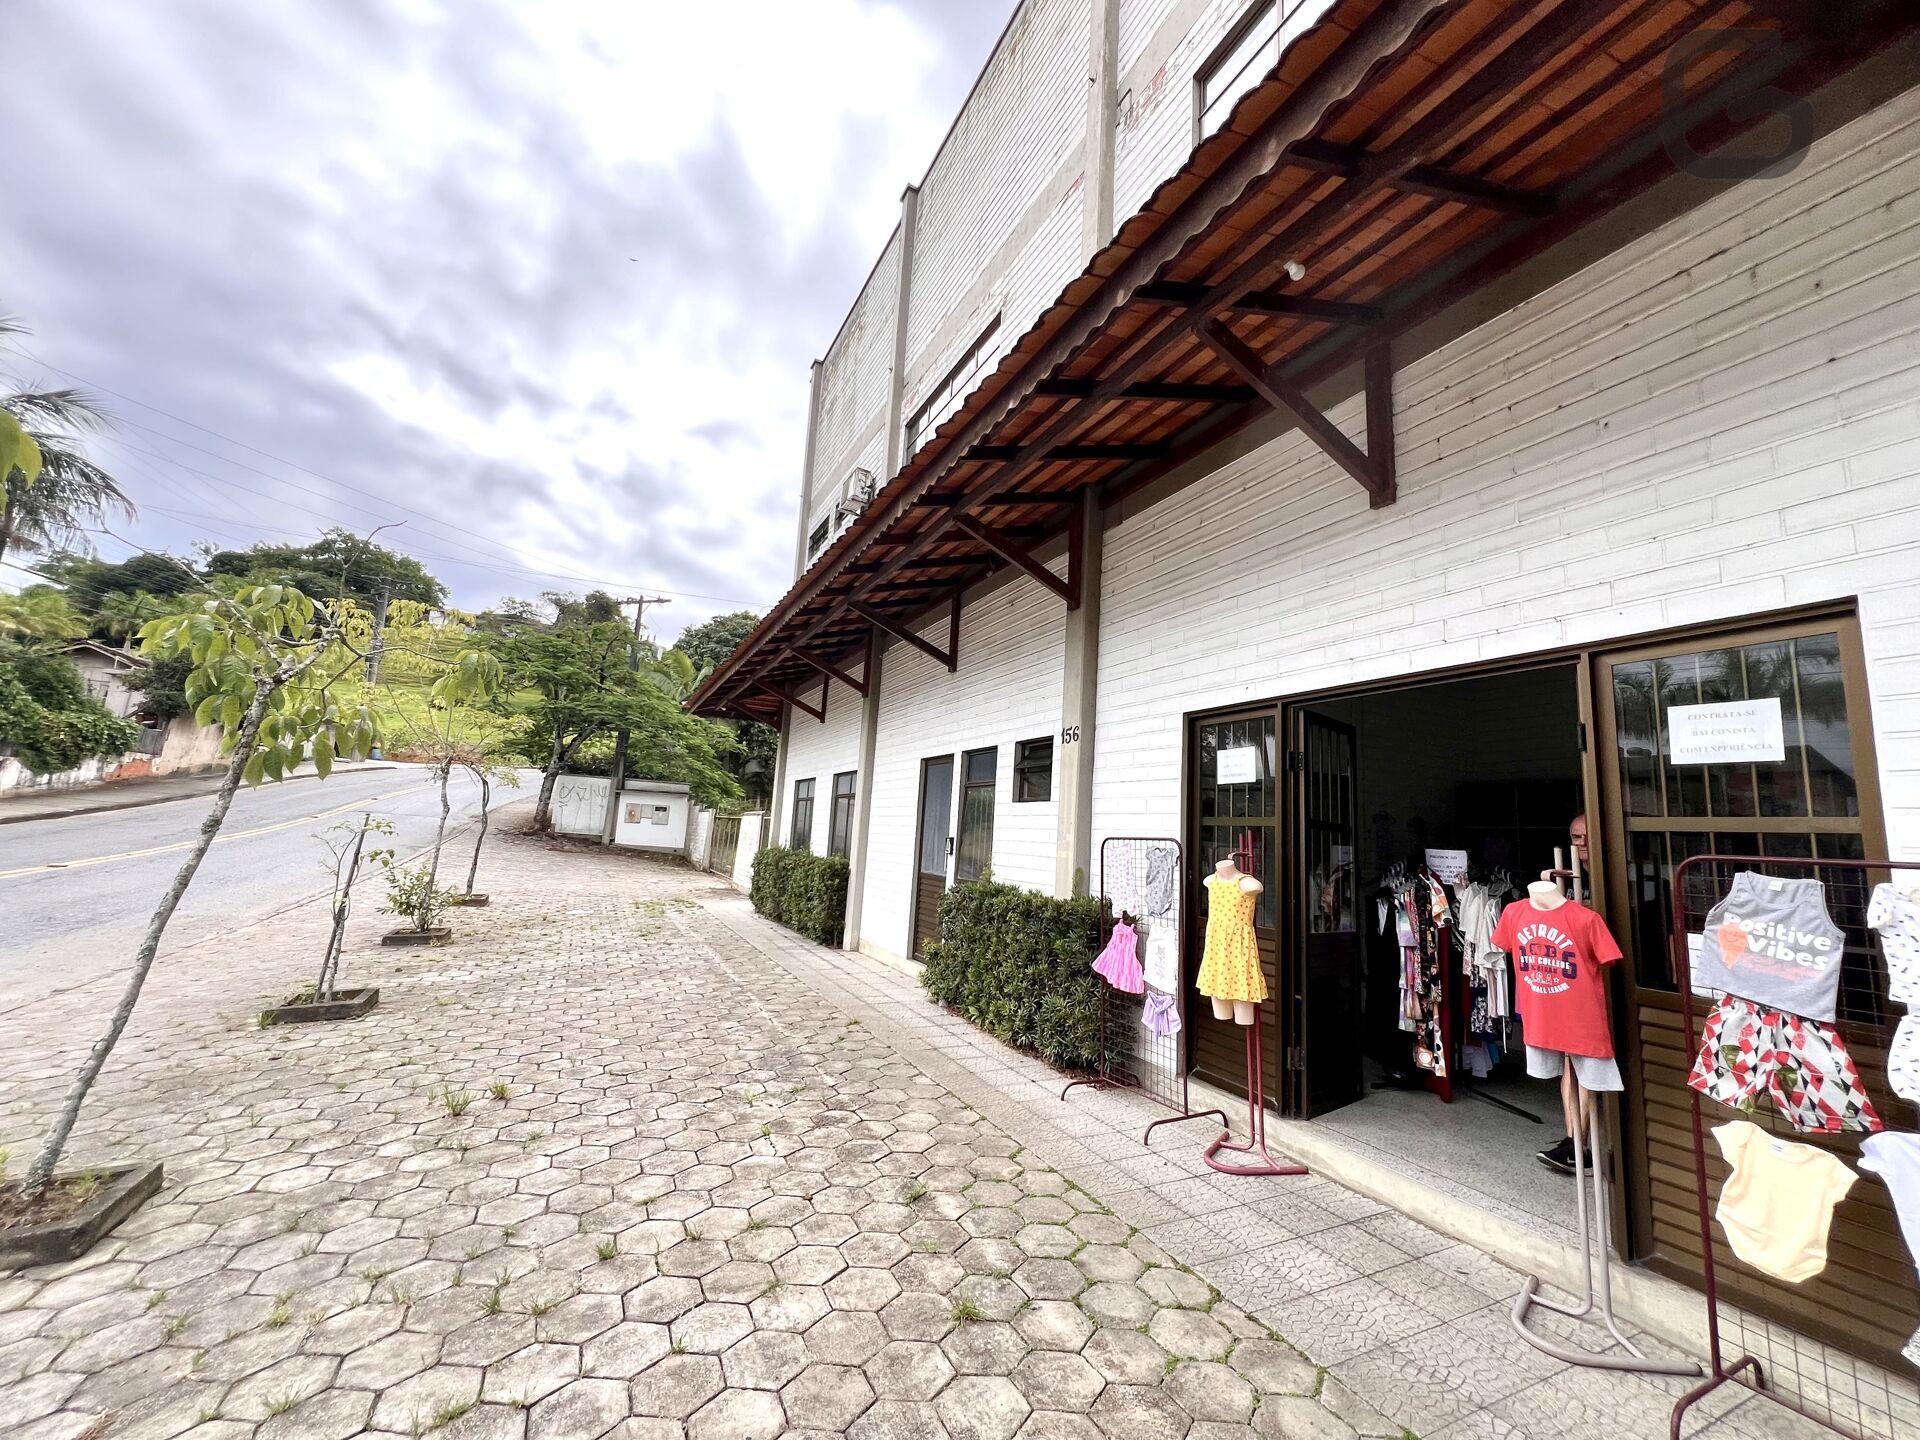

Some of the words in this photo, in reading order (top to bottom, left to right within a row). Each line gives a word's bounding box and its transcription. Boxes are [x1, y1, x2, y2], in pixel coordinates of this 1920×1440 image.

[1687, 708, 1758, 721] CONTRATA-SE
[1061, 725, 1080, 745] 156
[1692, 727, 1757, 737] BALCONISTA
[1679, 746, 1702, 754] COM
[1704, 742, 1773, 753] EXPERIÊNCIA
[1517, 923, 1574, 950] DETROIT
[1724, 911, 1832, 951] Positive
[1747, 934, 1830, 971] Vibes
[1537, 956, 1571, 970] COLLEGE
